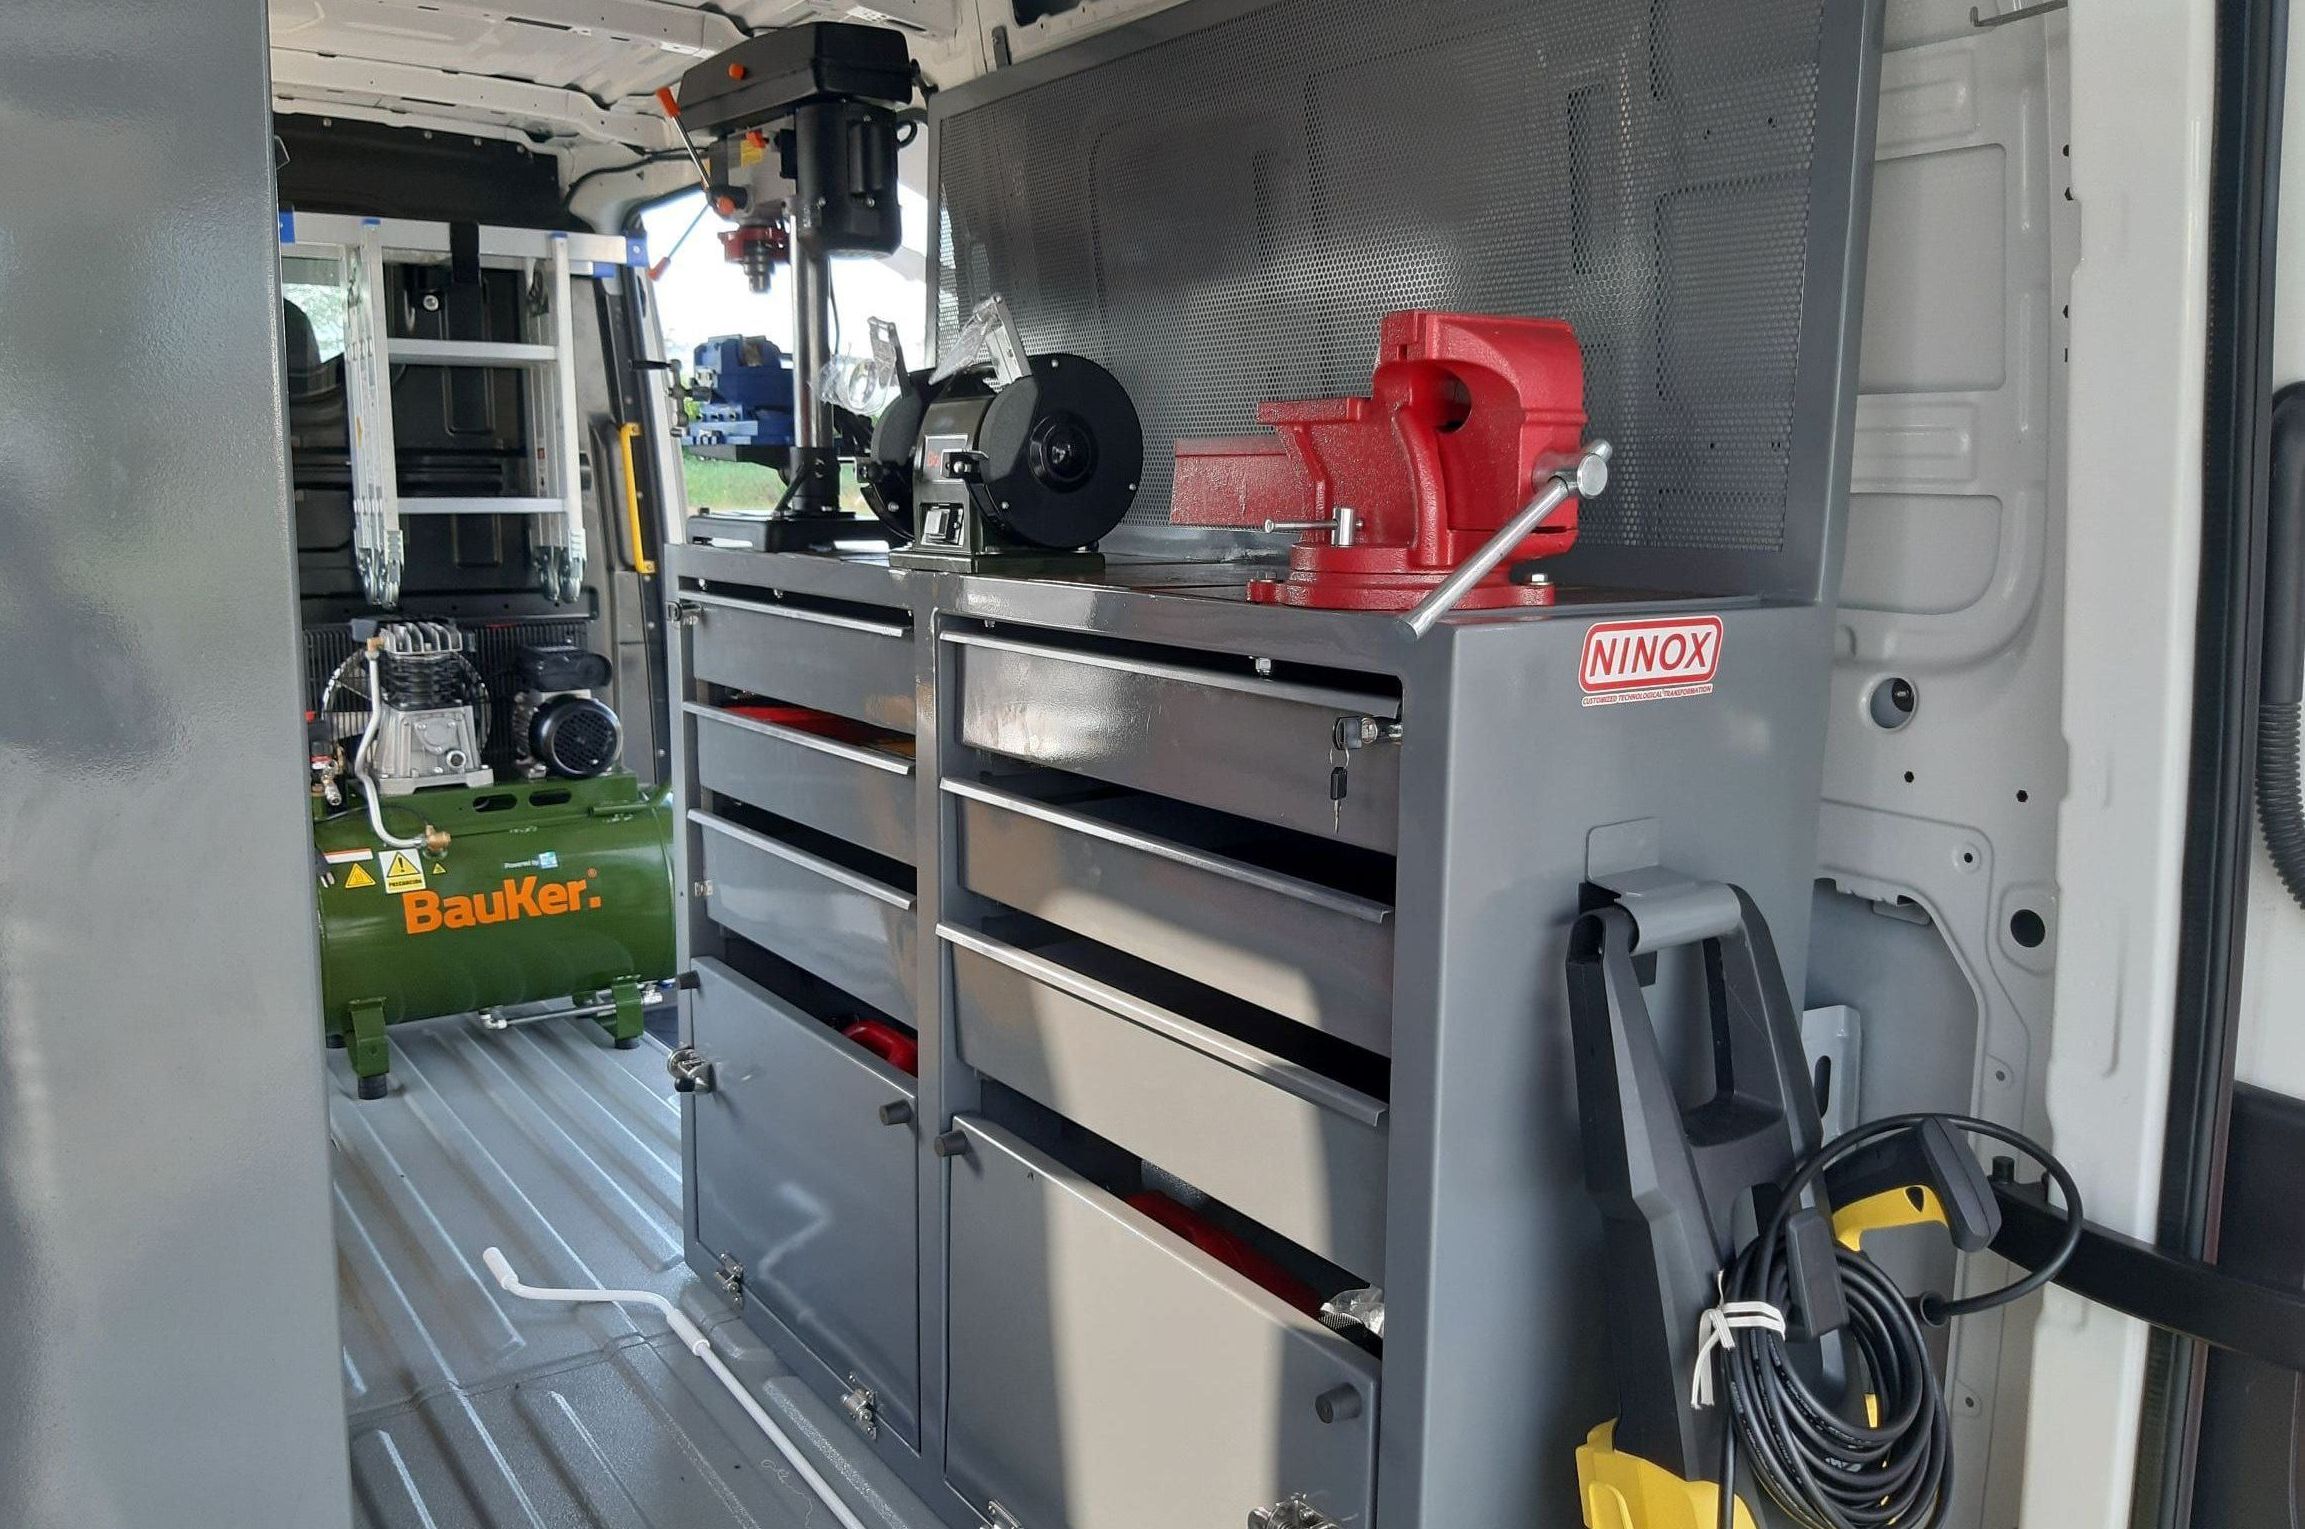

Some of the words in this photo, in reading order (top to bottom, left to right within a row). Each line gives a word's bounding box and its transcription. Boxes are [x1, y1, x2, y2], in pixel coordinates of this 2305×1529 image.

[1589, 631, 1712, 677] NINOX
[1618, 690, 1662, 702] TECHNOLOGICAL
[1664, 686, 1712, 697] TRANSFORMATION
